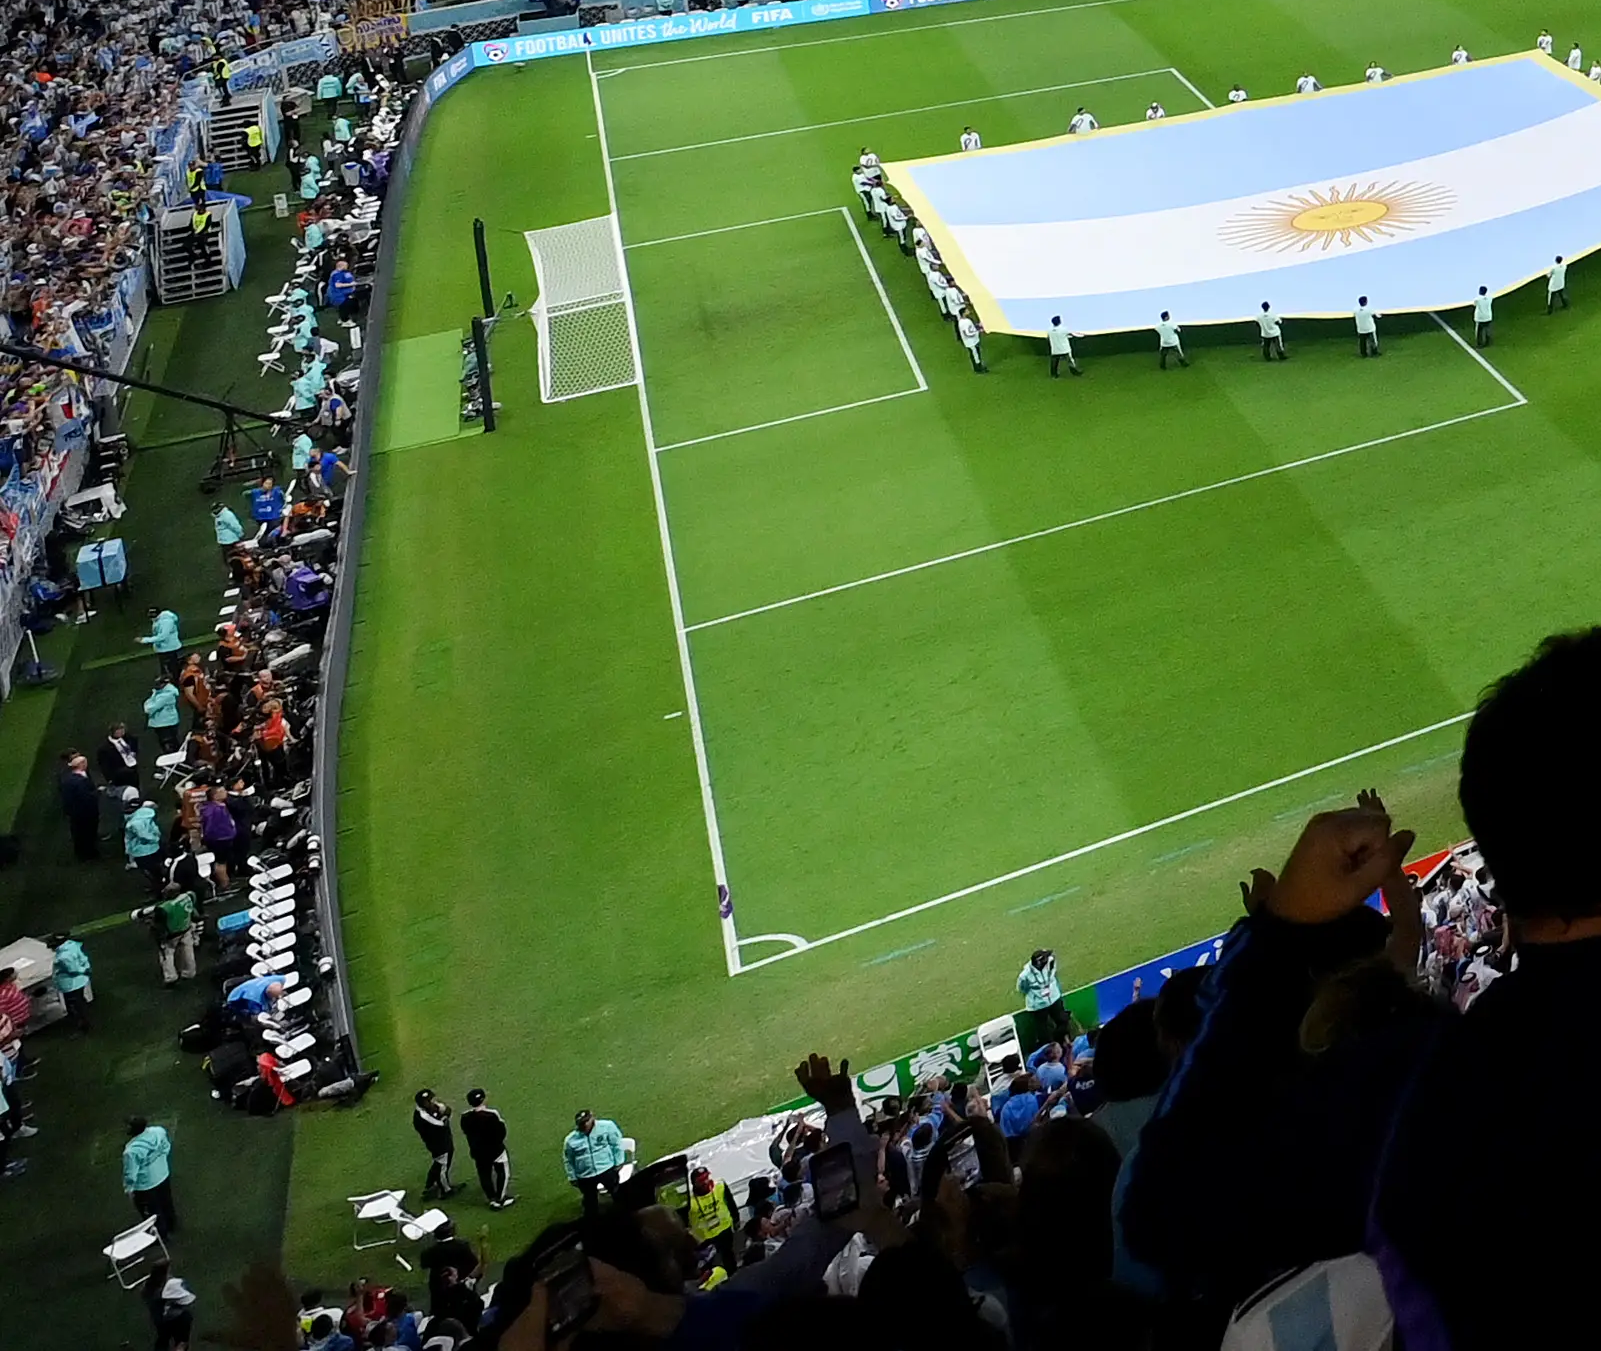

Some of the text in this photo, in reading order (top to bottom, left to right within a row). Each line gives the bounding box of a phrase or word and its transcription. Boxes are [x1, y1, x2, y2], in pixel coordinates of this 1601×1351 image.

[599, 24, 658, 46] UNITES
[662, 17, 690, 37] the
[690, 11, 738, 35] World
[751, 7, 793, 25] FIFA
